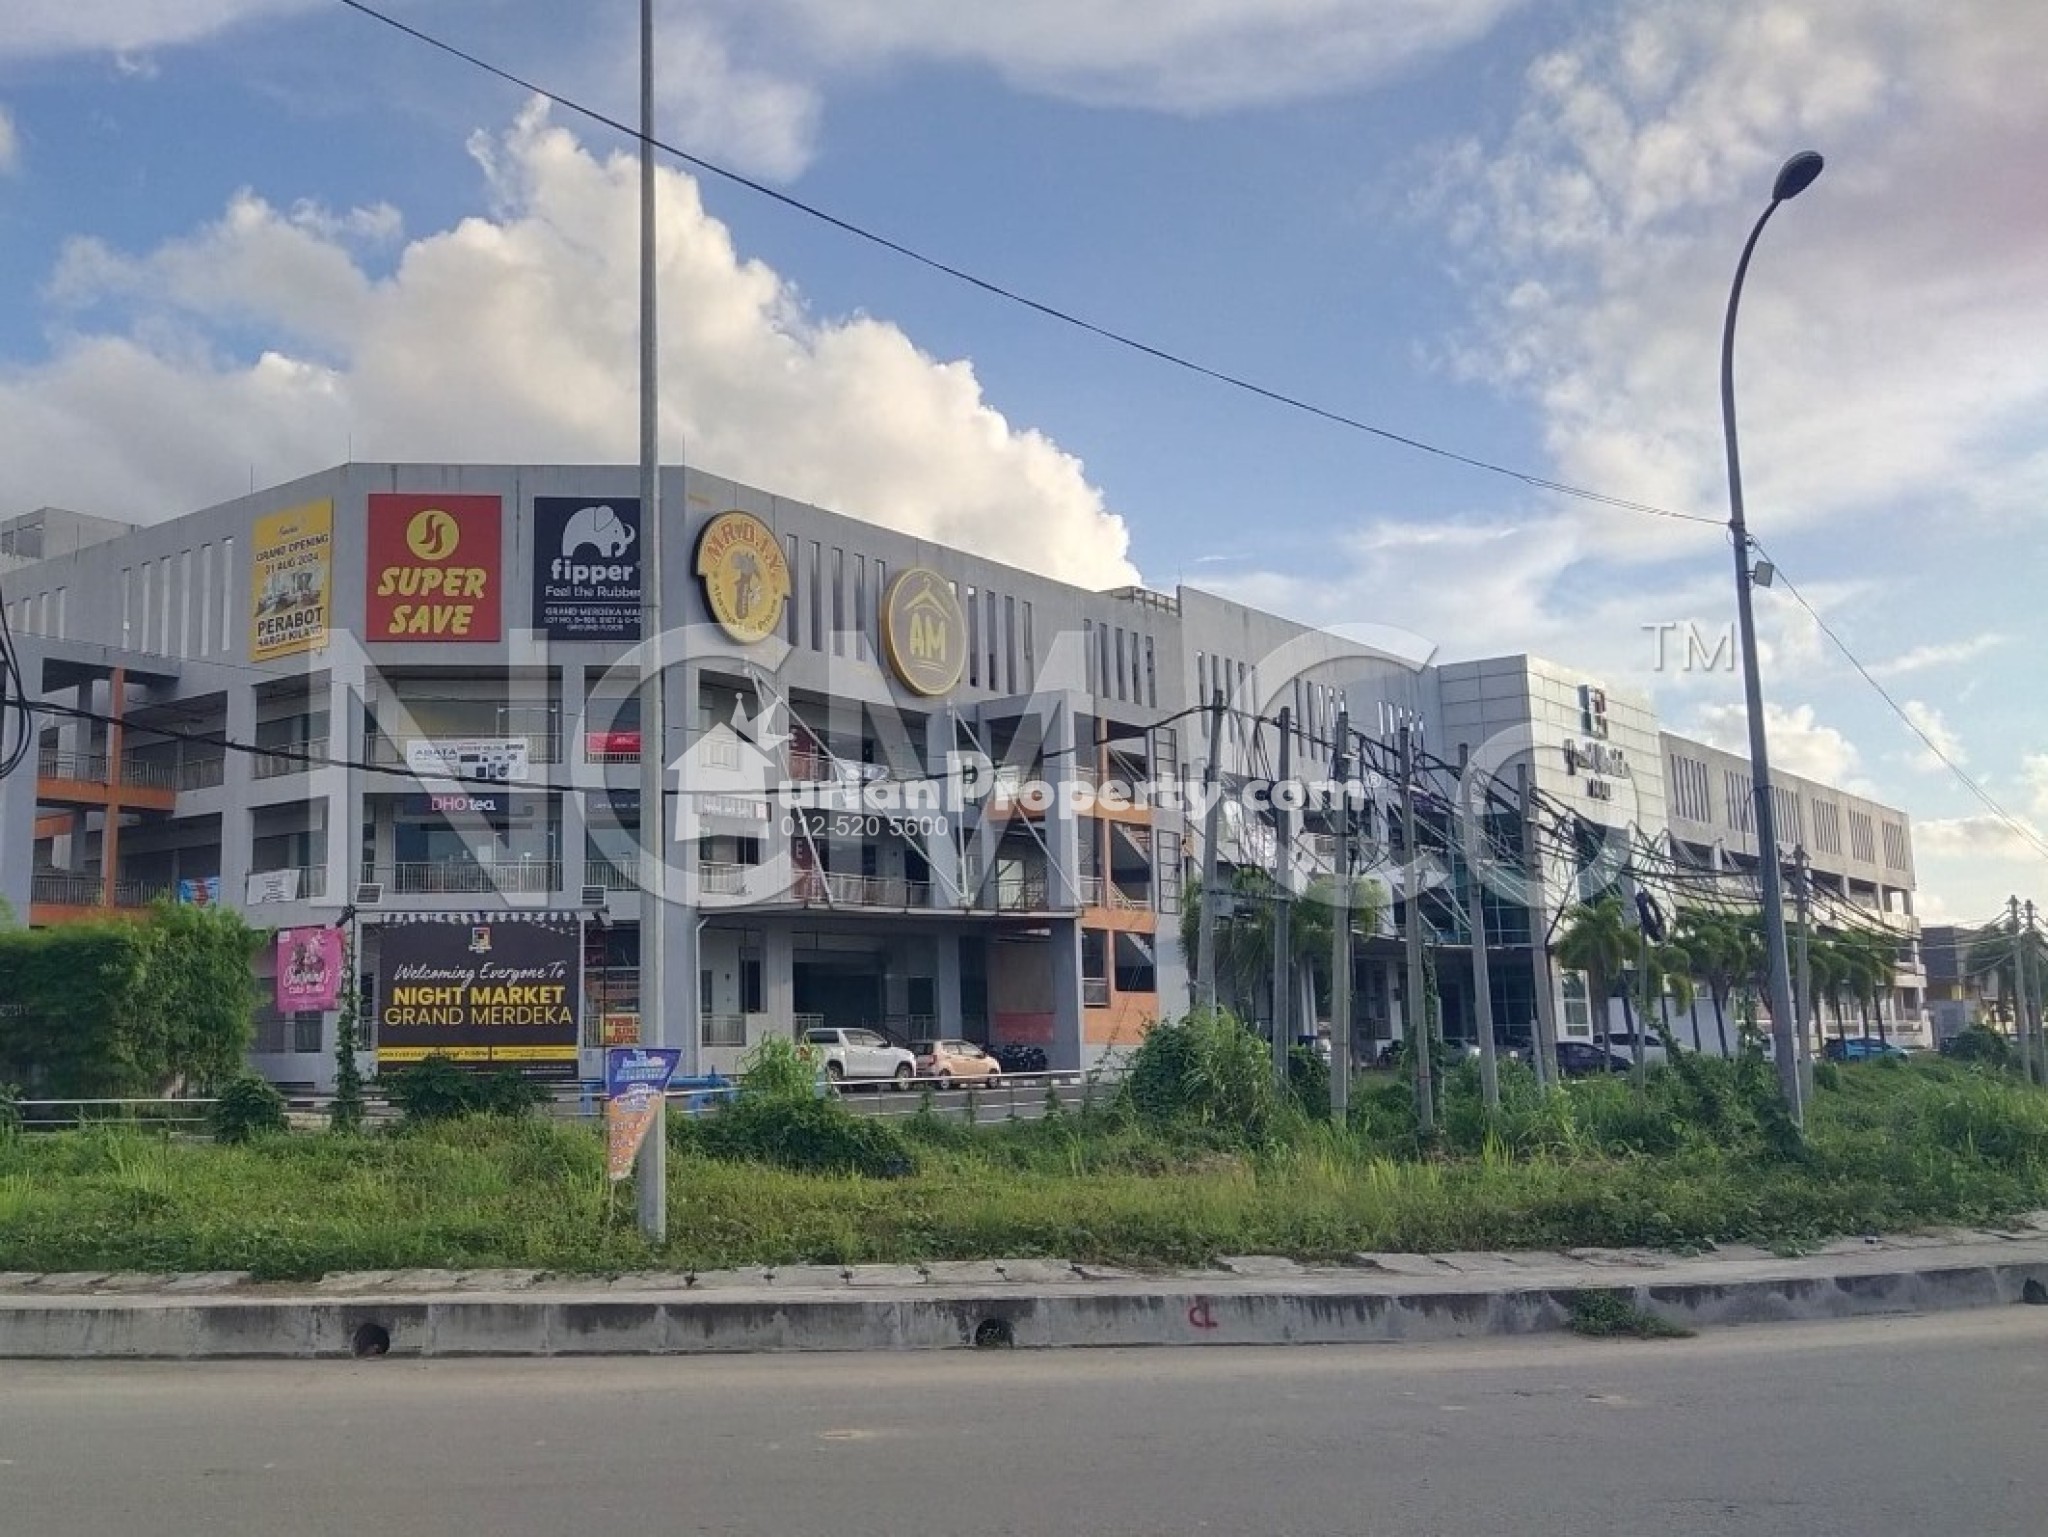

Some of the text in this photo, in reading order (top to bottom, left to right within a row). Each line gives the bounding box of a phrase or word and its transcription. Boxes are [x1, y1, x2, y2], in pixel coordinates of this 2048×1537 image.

[289, 534, 329, 552] OPENING
[277, 557, 296, 569] AUG
[551, 558, 634, 585] fipper
[377, 566, 487, 599] SUPER
[545, 585, 572, 597] Feel
[574, 585, 595, 597] the
[257, 607, 325, 637] PERABOT
[388, 604, 475, 635] SAVE
[909, 612, 946, 662] AM
[394, 962, 476, 992] Welcoming
[480, 961, 547, 988] Everyone
[548, 960, 568, 979] To
[393, 986, 566, 1006] NIGHT MARKET
[384, 1006, 574, 1026] GRAND MERDEKA
